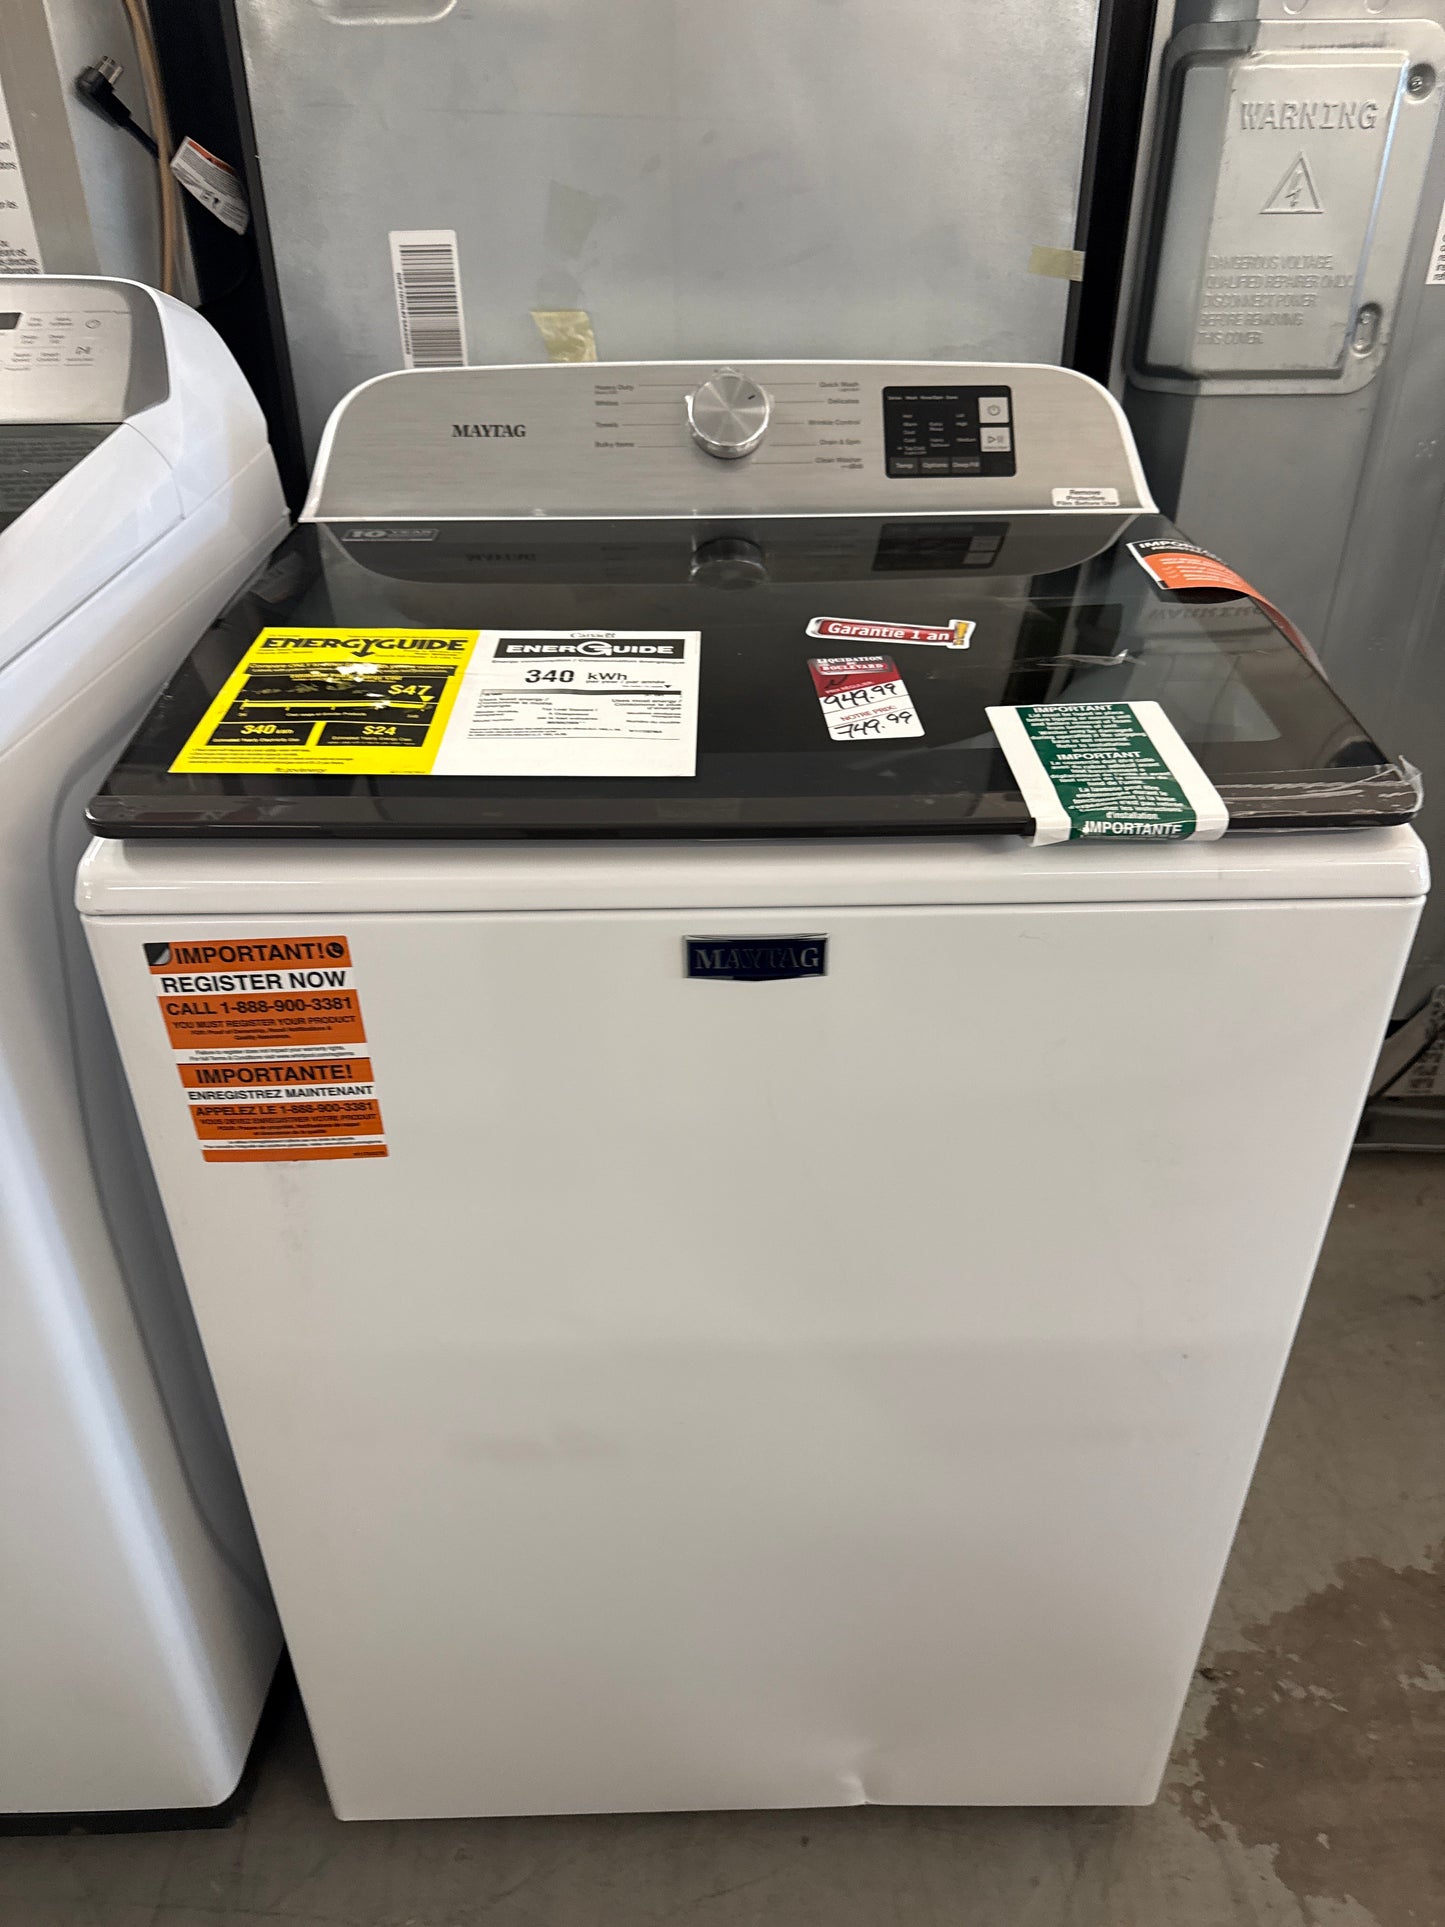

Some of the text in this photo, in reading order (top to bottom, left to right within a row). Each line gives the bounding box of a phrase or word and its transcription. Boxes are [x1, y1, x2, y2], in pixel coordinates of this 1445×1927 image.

[1240, 101, 1378, 130] WARNING
[452, 424, 526, 437] MAYTAG
[827, 622, 905, 639] Garantie
[910, 630, 920, 639] 1
[261, 638, 469, 655] ENERGYGUIDE
[505, 641, 675, 656] ENERGUIDE
[525, 669, 628, 683] 340 kWh
[823, 683, 898, 709] 949.99
[840, 710, 871, 721] NOTRE
[362, 726, 397, 735] $24
[834, 711, 912, 738] 749.99
[1056, 752, 1141, 760] IMPORTANT
[175, 943, 324, 965] IMPORTANT!
[694, 948, 819, 969] MAYTAG
[161, 971, 346, 993] REGISTER NOW
[166, 997, 352, 1016] CALL 1-888-900-3381
[173, 1015, 356, 1029] YOU MUST REGISTER YOUR PRODUCT
[195, 1064, 353, 1084] IMPORTANTE!
[188, 1086, 374, 1100] ENREGISTREZ MAINTENANT
[196, 1102, 373, 1116] APPELEZ LE 1-888-900-3381
